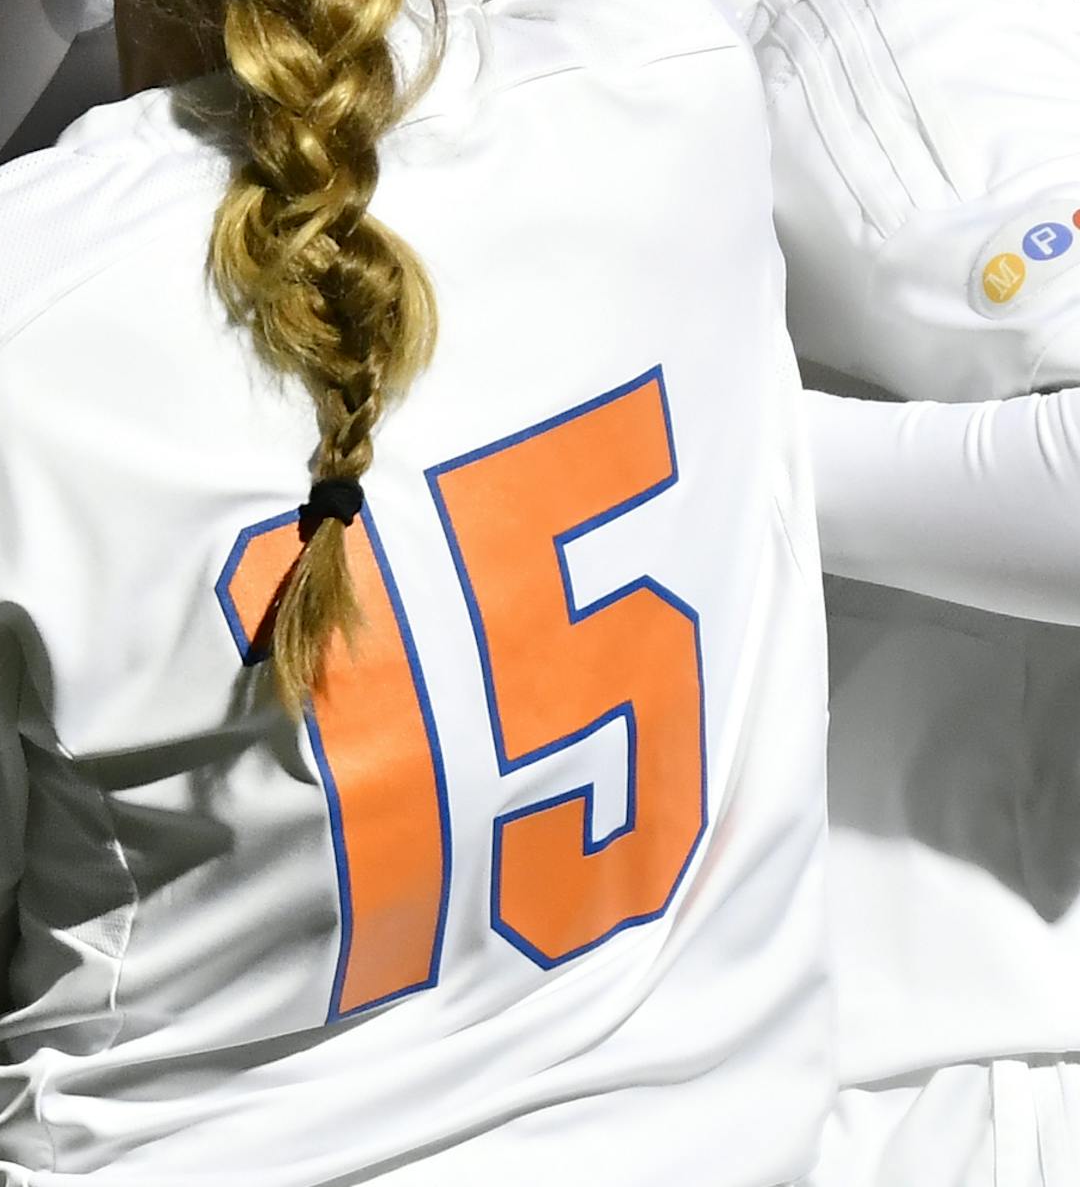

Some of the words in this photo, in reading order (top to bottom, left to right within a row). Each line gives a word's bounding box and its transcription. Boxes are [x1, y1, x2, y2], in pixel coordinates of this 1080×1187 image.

[984, 256, 1021, 300] M
[1030, 226, 1057, 255] P
[214, 363, 709, 1025] 15
